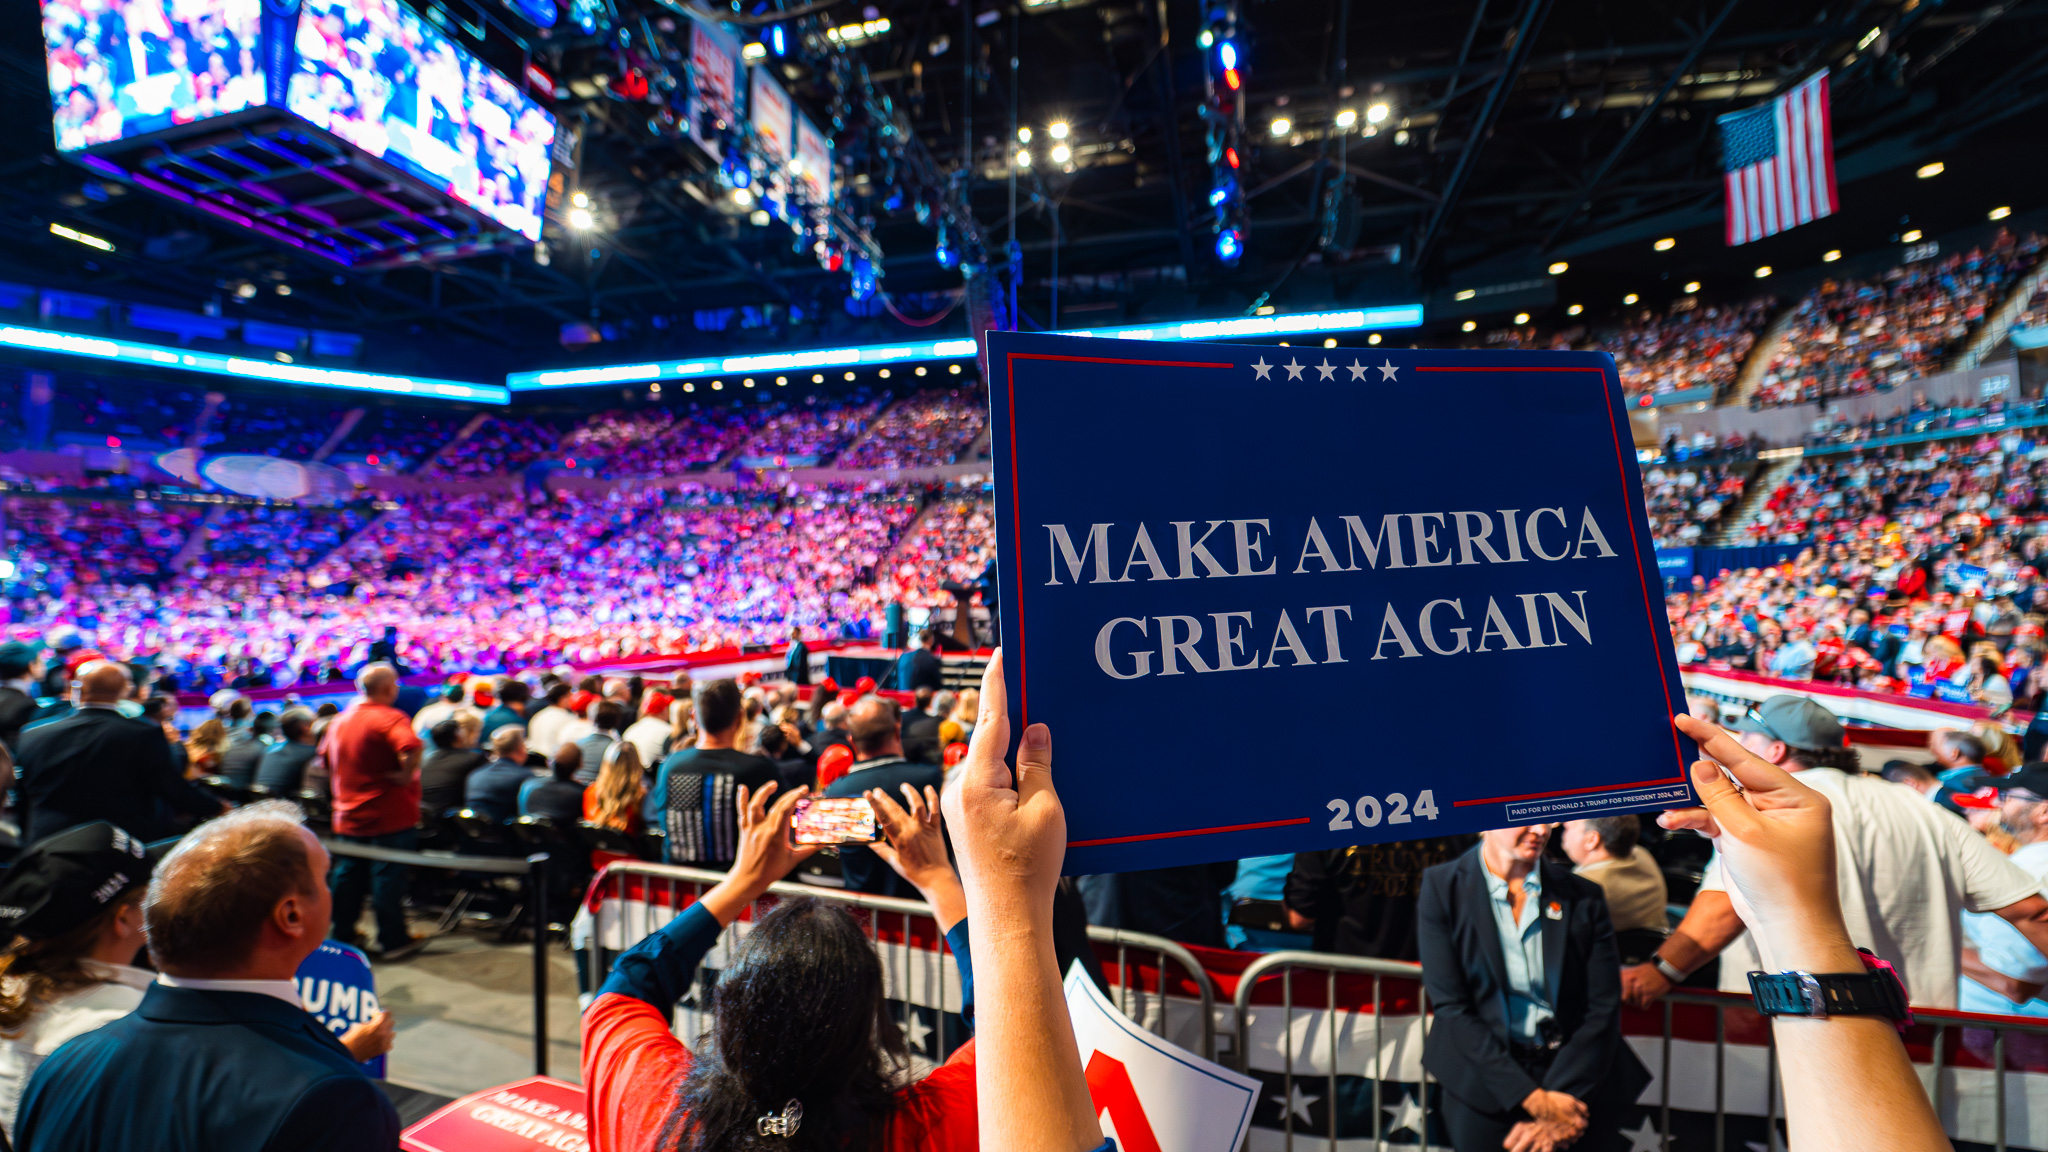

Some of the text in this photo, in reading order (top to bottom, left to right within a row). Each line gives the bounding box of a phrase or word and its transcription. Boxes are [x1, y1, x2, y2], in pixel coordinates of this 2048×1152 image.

[1042, 505, 1619, 586] MAKE AMERICA
[1094, 590, 1593, 680] GREAT AGAIN
[1326, 789, 1440, 832] 2024
[1511, 808, 1528, 816] PAID
[1528, 806, 1541, 814] FOR
[1552, 802, 1579, 811] DONALD
[1586, 798, 1608, 807] TRUMP
[1609, 797, 1622, 805] FOR
[1623, 793, 1657, 803] PRESIDENT
[1656, 791, 1673, 800] 2024,
[1673, 789, 1686, 797] INC.
[294, 976, 379, 1024] UMP
[470, 1104, 551, 1139] GREAT
[488, 1091, 560, 1117] MAKE
